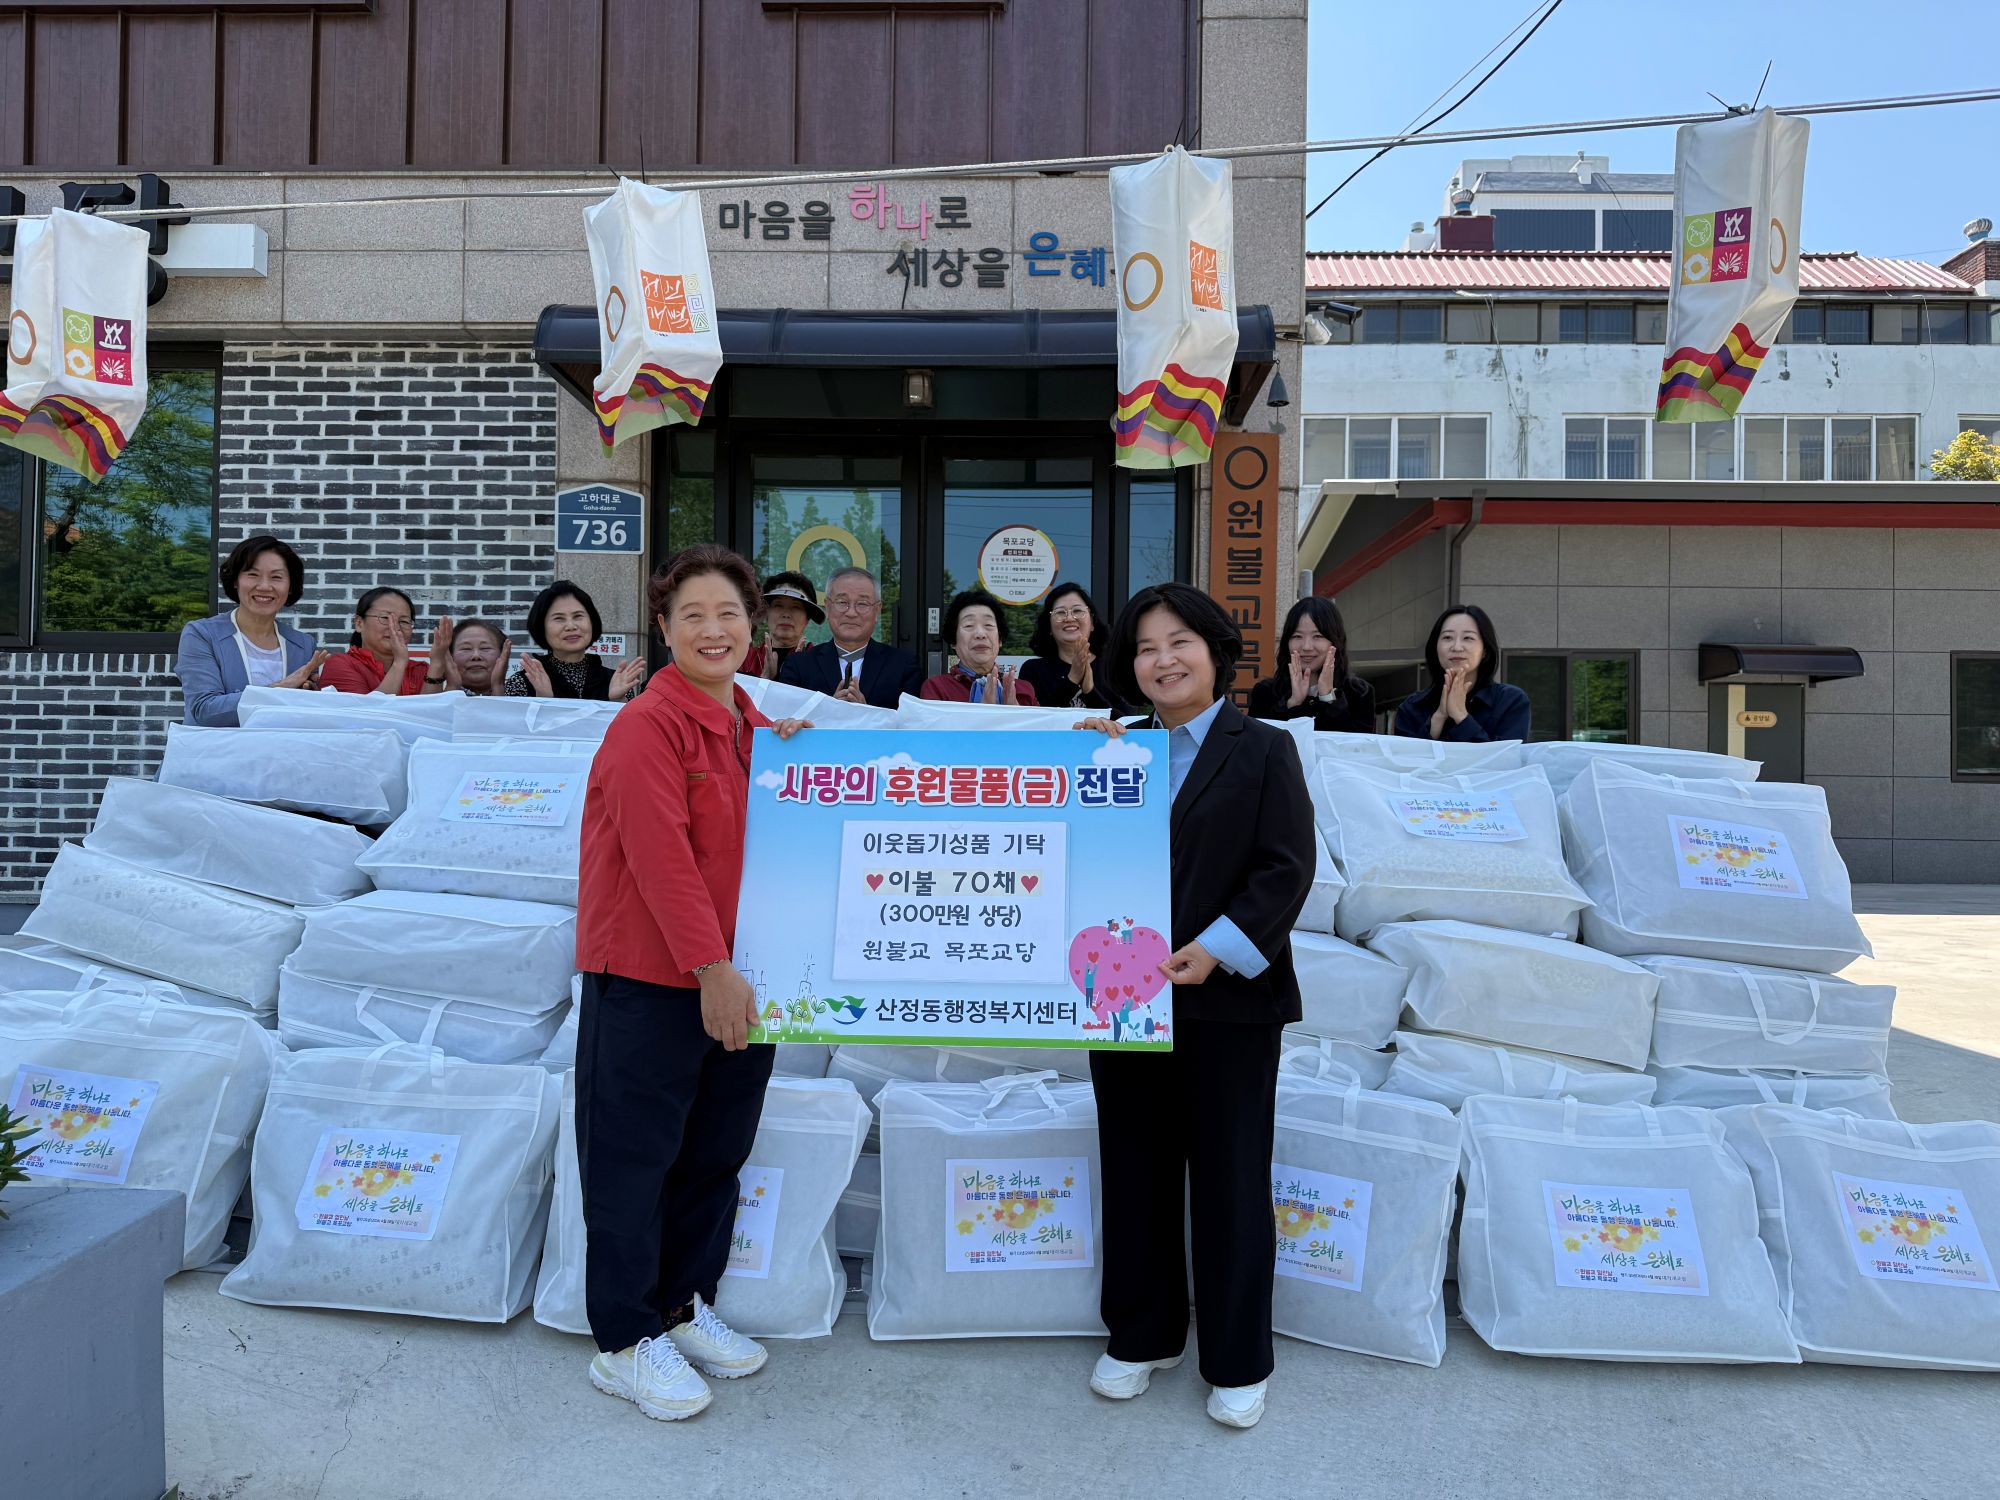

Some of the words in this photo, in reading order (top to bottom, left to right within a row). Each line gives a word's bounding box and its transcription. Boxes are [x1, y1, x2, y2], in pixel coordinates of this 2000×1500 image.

[719, 199, 835, 240] 마음을
[848, 184, 972, 240] 하나로
[886, 247, 1010, 288] 세상을
[1023, 231, 1116, 287] 은혜
[577, 493, 621, 503] 고하대로
[572, 519, 627, 546] 736
[1002, 537, 1036, 547] 목포교당
[781, 766, 875, 803] 사랑의
[885, 765, 1068, 805] 후원물품(금)
[1076, 766, 1145, 804] 전달
[863, 833, 991, 855] 이웃돕기성품
[1003, 833, 1046, 855] 기탁
[1684, 825, 1719, 840] 마음을
[1723, 831, 1750, 843] 하나로
[888, 870, 937, 895] 이불
[952, 870, 1017, 895] 70채
[1717, 866, 1747, 878] 세상을
[1750, 867, 1786, 880] 은혜로
[879, 903, 970, 927] (300만원
[979, 903, 1022, 927] 상당)
[862, 940, 931, 962] 원불교
[944, 941, 1037, 963] 목포교당
[874, 999, 1078, 1026] 산정동행정복지센터
[32, 1079, 75, 1101] 마음을
[78, 1086, 111, 1104] 하나로
[31, 1099, 62, 1110] 아름다운
[39, 1139, 74, 1155] 세상을
[76, 1138, 116, 1159] 은혜로
[336, 1139, 374, 1158] 마음을
[377, 1141, 408, 1159] 하나로
[334, 1159, 362, 1168] 아름다운
[403, 1163, 436, 1174] 나눕니다.
[963, 1170, 1004, 1191] 마음을
[1009, 1170, 1042, 1189] 하나로
[1287, 1180, 1320, 1200] 하나로
[342, 1197, 378, 1213] 세상을
[380, 1195, 424, 1215] 은혜로
[967, 1192, 996, 1200] 아름다운
[1561, 1195, 1604, 1214] 마음을
[1608, 1198, 1643, 1215] 하나로
[1850, 1187, 1891, 1208] 마음을
[1893, 1193, 1927, 1209] 하나로
[1567, 1213, 1599, 1223] 아름다운
[1644, 1219, 1678, 1228] 나눕니다.
[731, 1230, 752, 1251] 혜로
[992, 1230, 1027, 1247] 세상을
[1031, 1222, 1073, 1244] 은혜로
[1276, 1238, 1298, 1254] 상을
[1300, 1240, 1344, 1262] 은혜로
[1601, 1252, 1637, 1267] 세상을
[1641, 1250, 1684, 1270] 은혜로
[1895, 1244, 1929, 1260] 세상을
[1932, 1244, 1972, 1265] 은혜로
